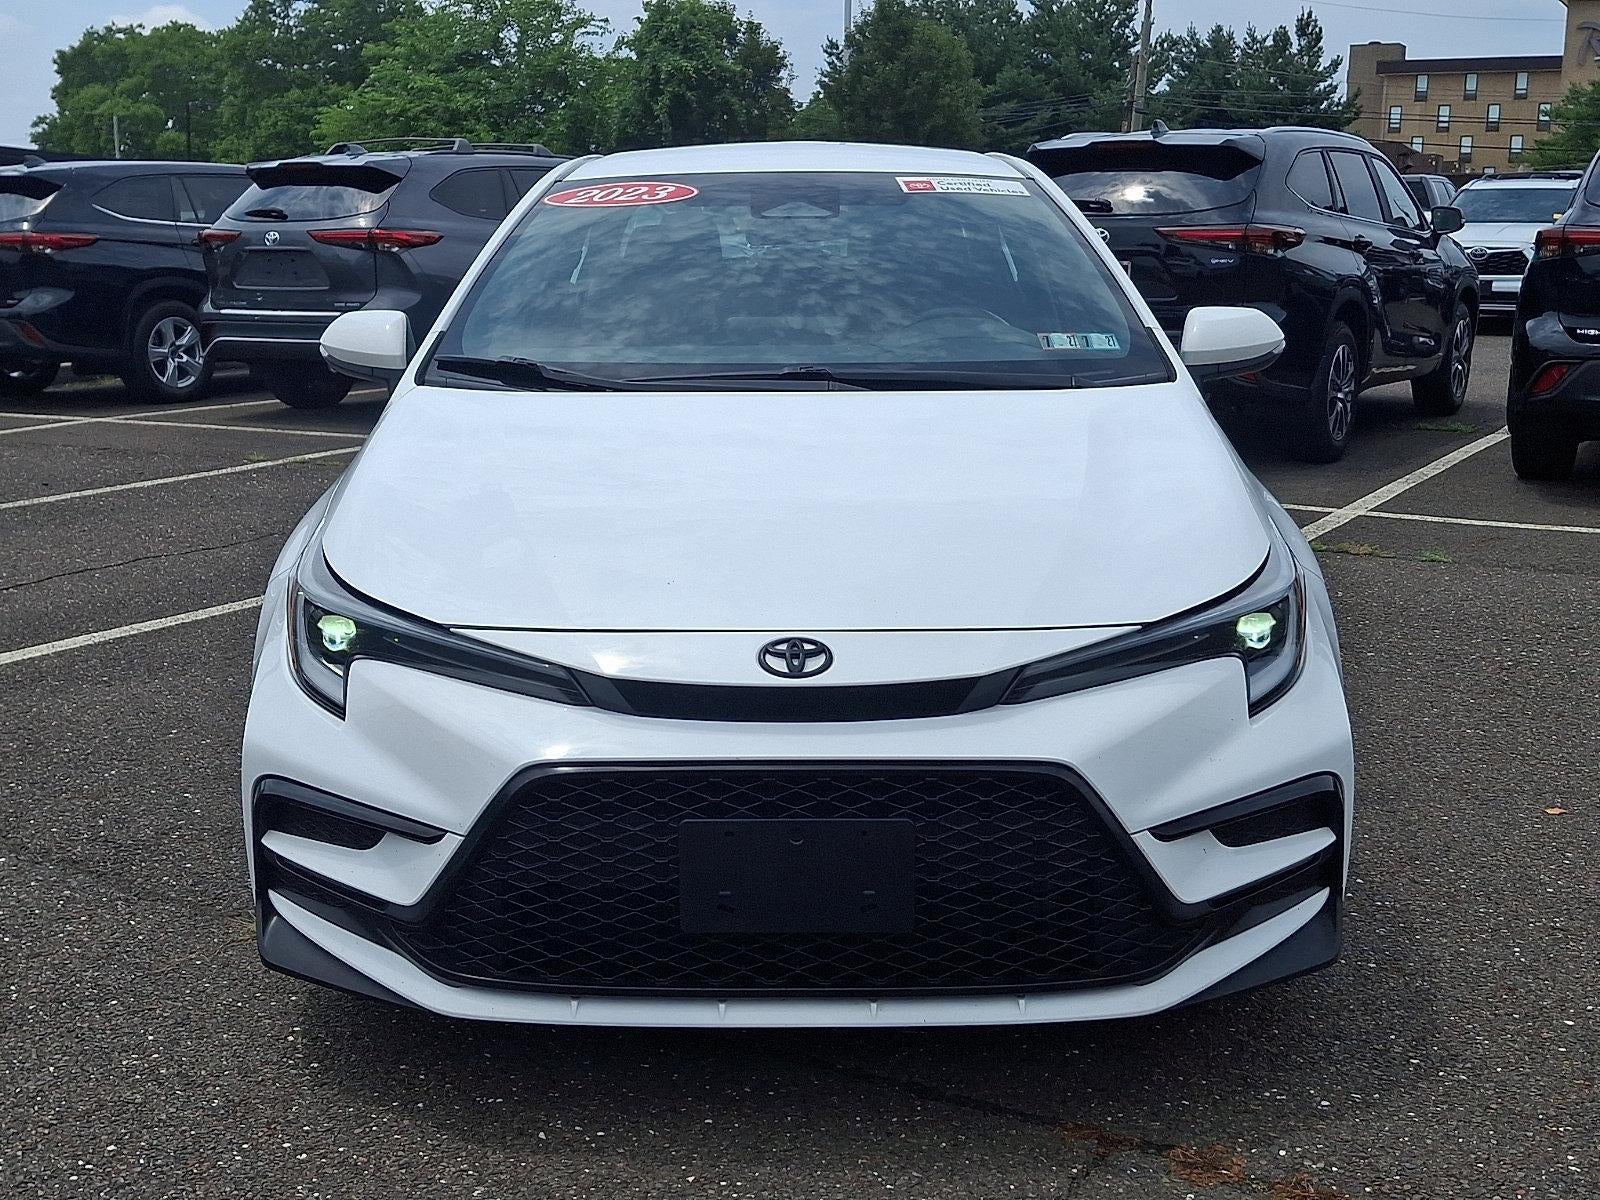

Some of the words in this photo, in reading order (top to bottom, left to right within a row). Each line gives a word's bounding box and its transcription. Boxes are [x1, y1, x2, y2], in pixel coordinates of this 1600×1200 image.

[937, 180, 991, 188] Certified
[564, 185, 677, 205] 2023
[974, 187, 1025, 195] Vehicles
